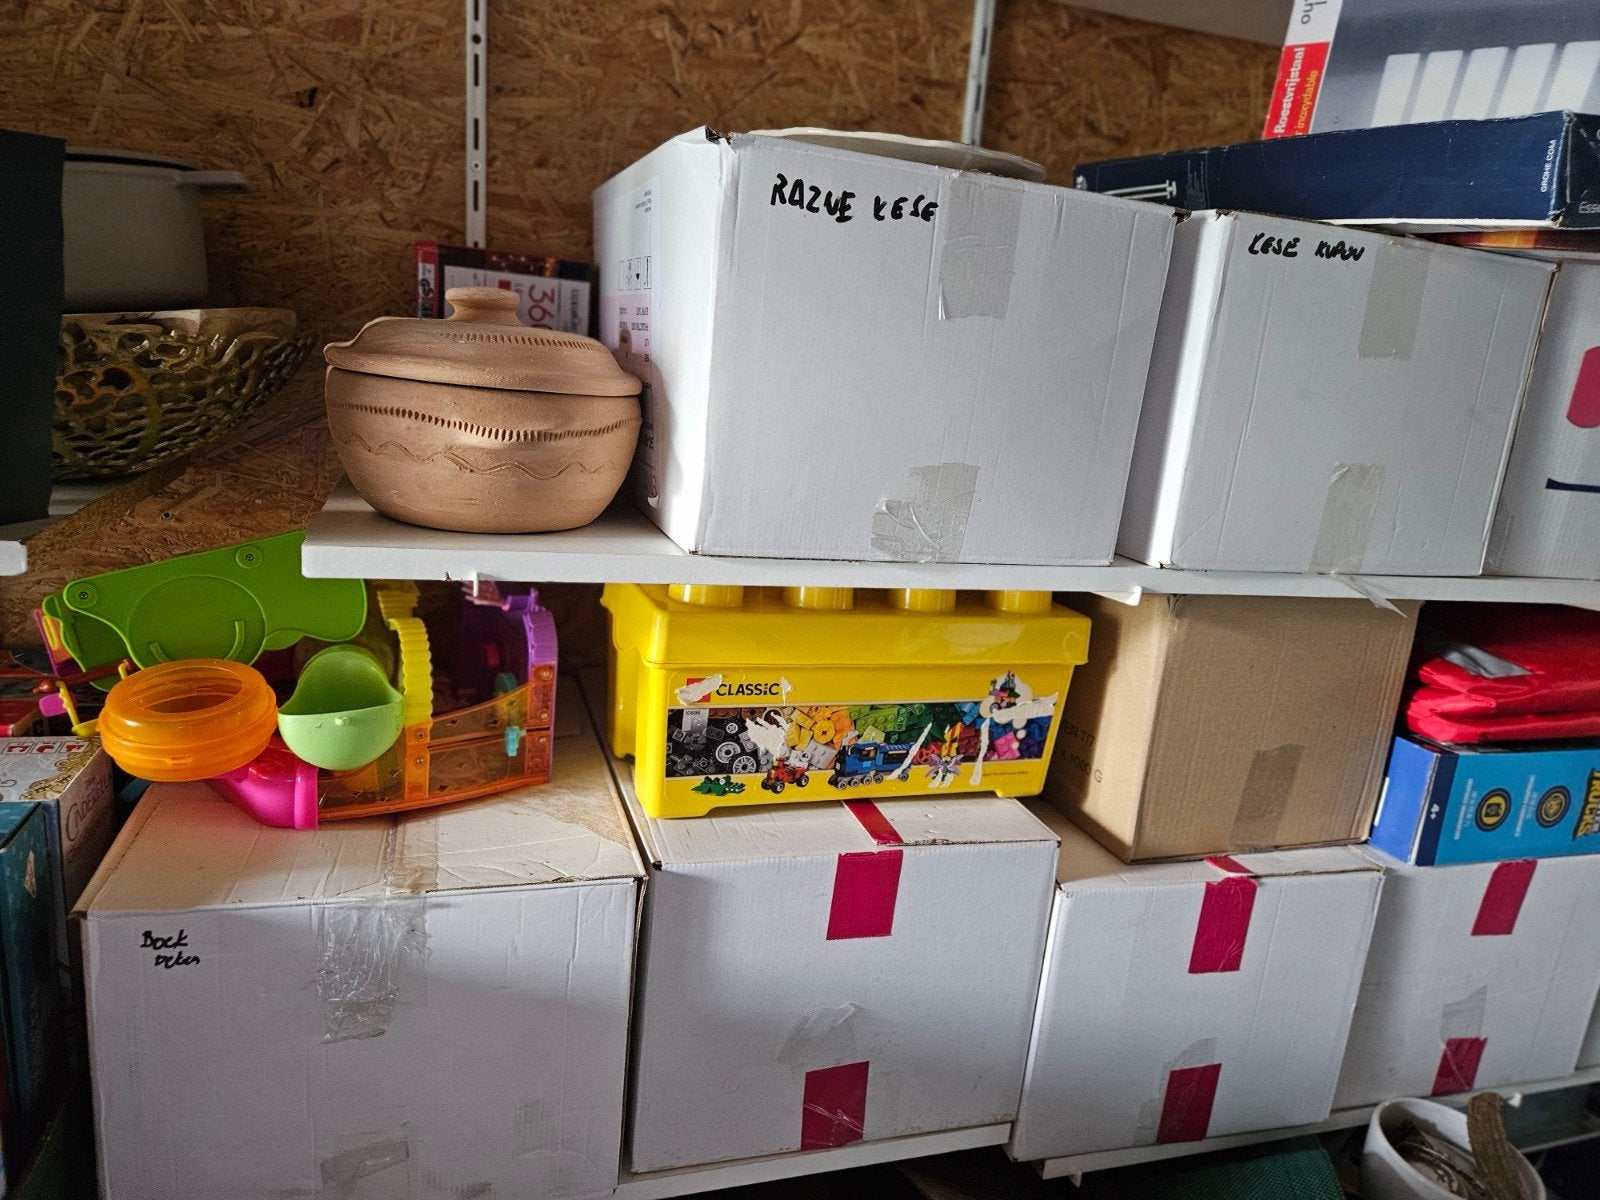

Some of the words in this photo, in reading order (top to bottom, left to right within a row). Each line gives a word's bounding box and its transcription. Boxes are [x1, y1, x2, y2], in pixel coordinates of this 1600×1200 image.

[1273, 47, 1305, 133] Roestvrijstaal
[1540, 139, 1557, 193] GROHE.COM
[1094, 769, 1103, 783] G
